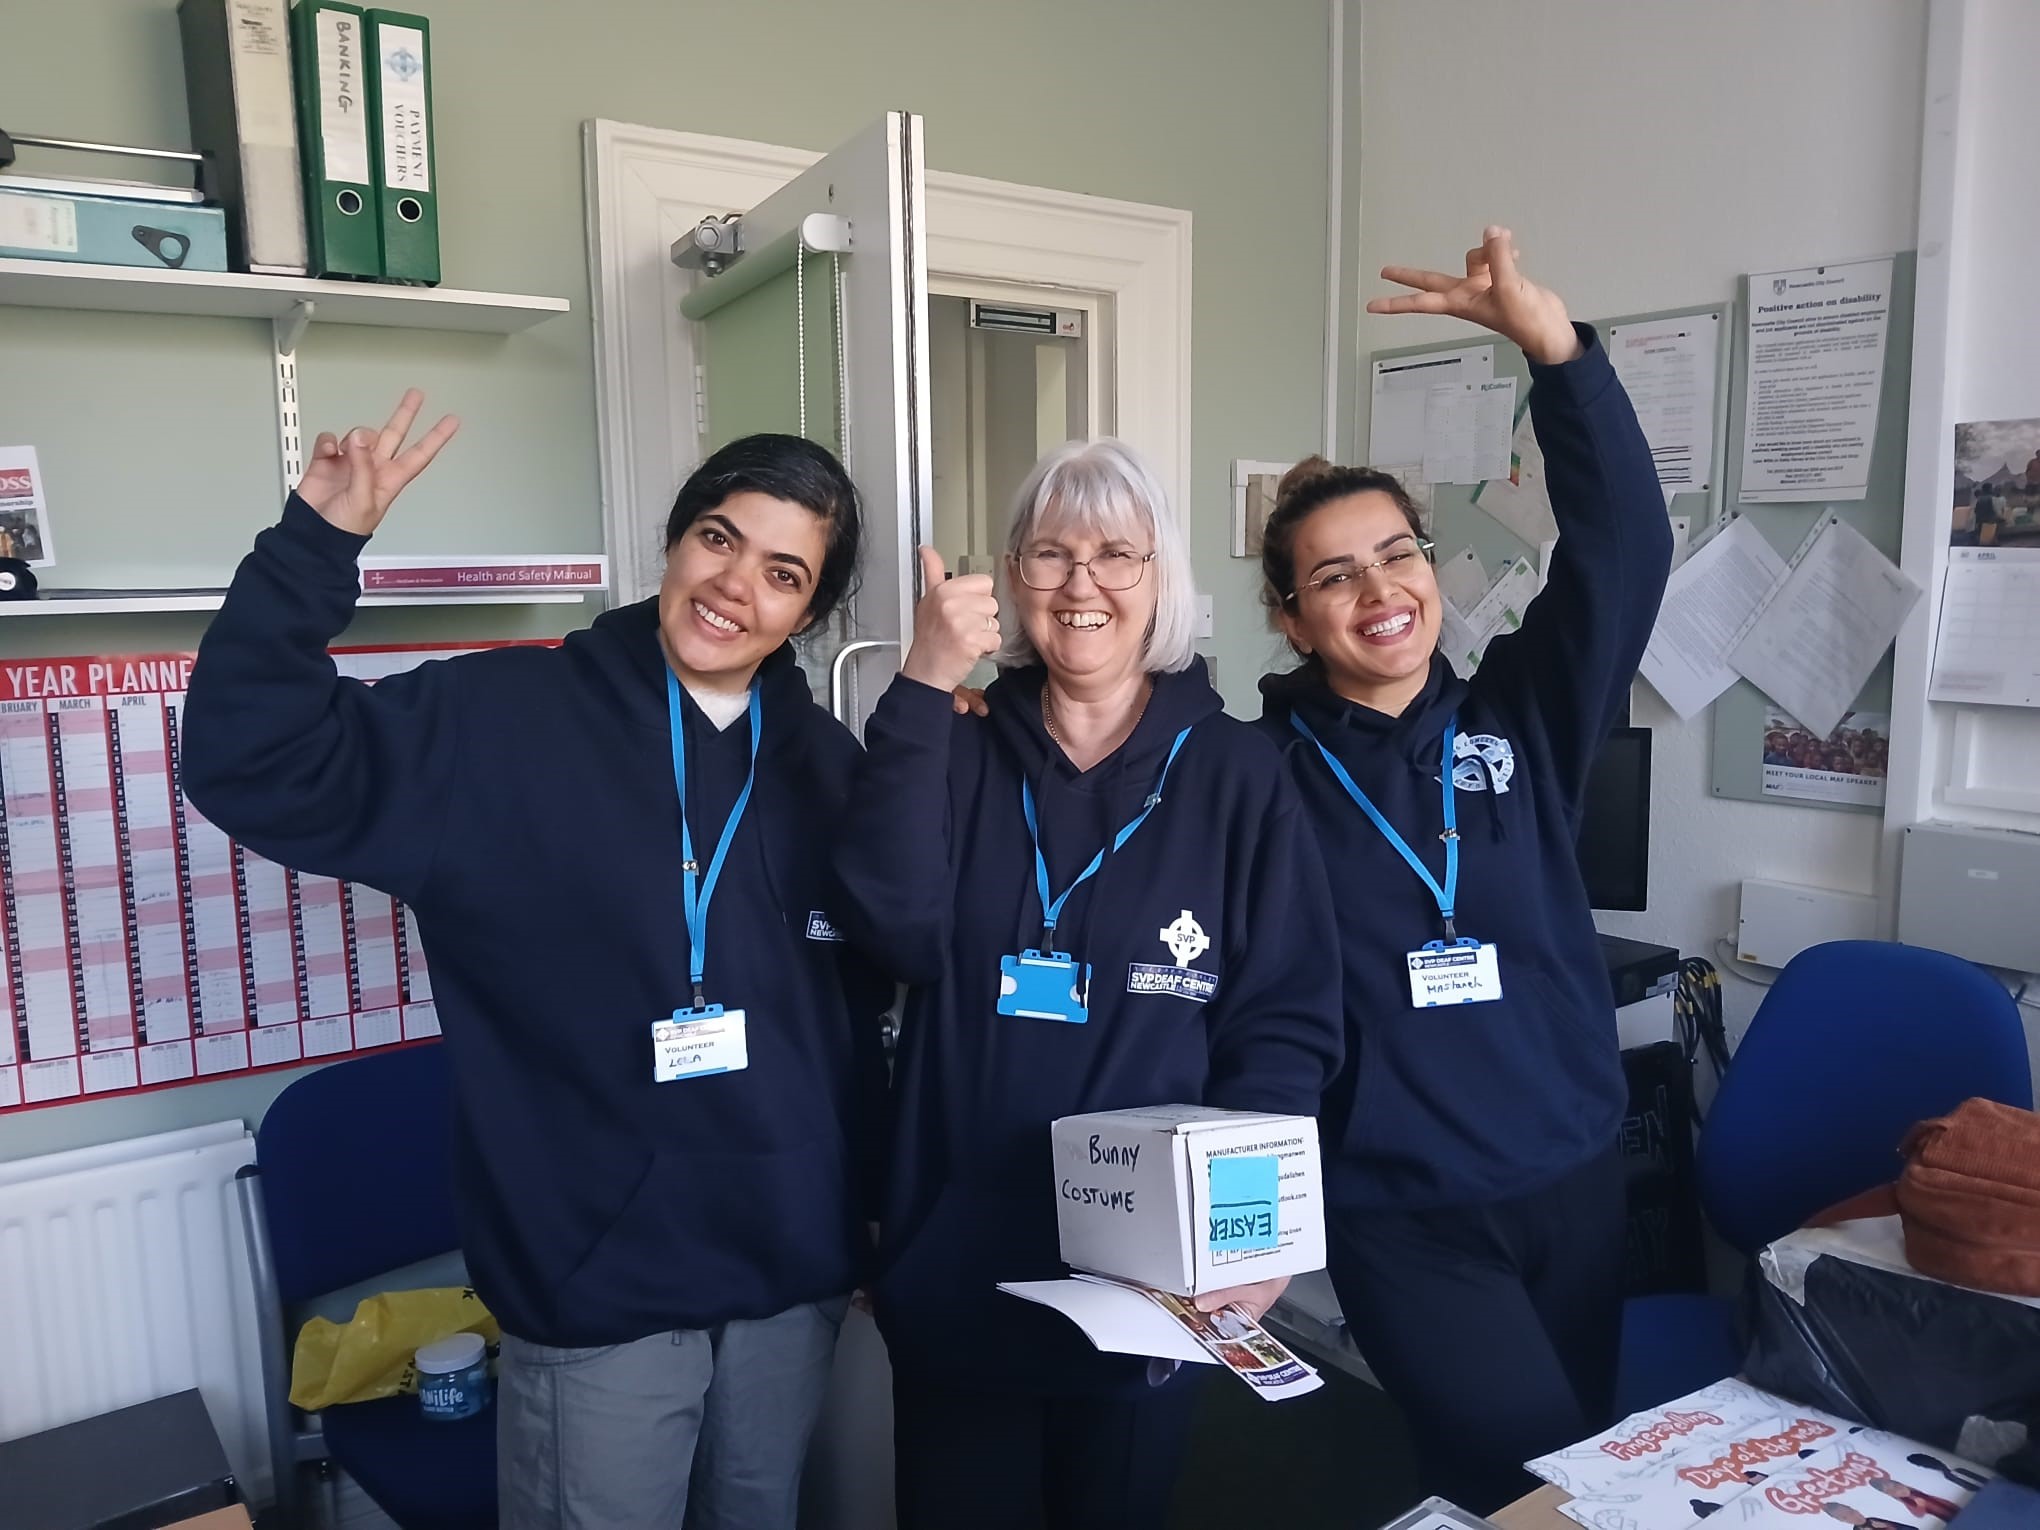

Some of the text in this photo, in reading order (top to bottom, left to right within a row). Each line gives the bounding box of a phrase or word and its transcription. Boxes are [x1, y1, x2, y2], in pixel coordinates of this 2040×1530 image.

[336, 21, 352, 113] BANKING
[394, 104, 407, 182] VOUCHERS
[410, 110, 424, 178] PAYMENT
[1758, 304, 1794, 314] Positive
[1796, 301, 1824, 310] action
[1840, 294, 1881, 304] disability
[458, 570, 592, 584] Health and Safety Manual
[6, 660, 192, 698] YEAR PLANNE
[1, 702, 38, 714] BRUARY
[59, 699, 91, 709] MARCH
[122, 696, 146, 706] APRIL
[1805, 773, 1827, 781] LOCAL
[810, 929, 836, 938] NEWC
[1176, 934, 1196, 944] SVP
[1130, 982, 1176, 990] NEWCASTLE
[1132, 972, 1154, 982] SVP
[1155, 974, 1182, 984] DEAF
[1182, 978, 1214, 992] CENTRE
[1422, 972, 1469, 981] VOLUNTEER
[665, 1041, 714, 1054] VOLUNTEER
[1089, 1134, 1140, 1172] Bunny
[1206, 1138, 1304, 1158] MANUFACTURER INFORMATION
[1062, 1180, 1136, 1213] COSTUME
[1209, 1212, 1272, 1241] EASTER
[1687, 1460, 1740, 1485] Days
[1738, 1444, 1761, 1461] of
[1758, 1436, 1792, 1456] the
[1771, 1454, 1884, 1512] Greetings
